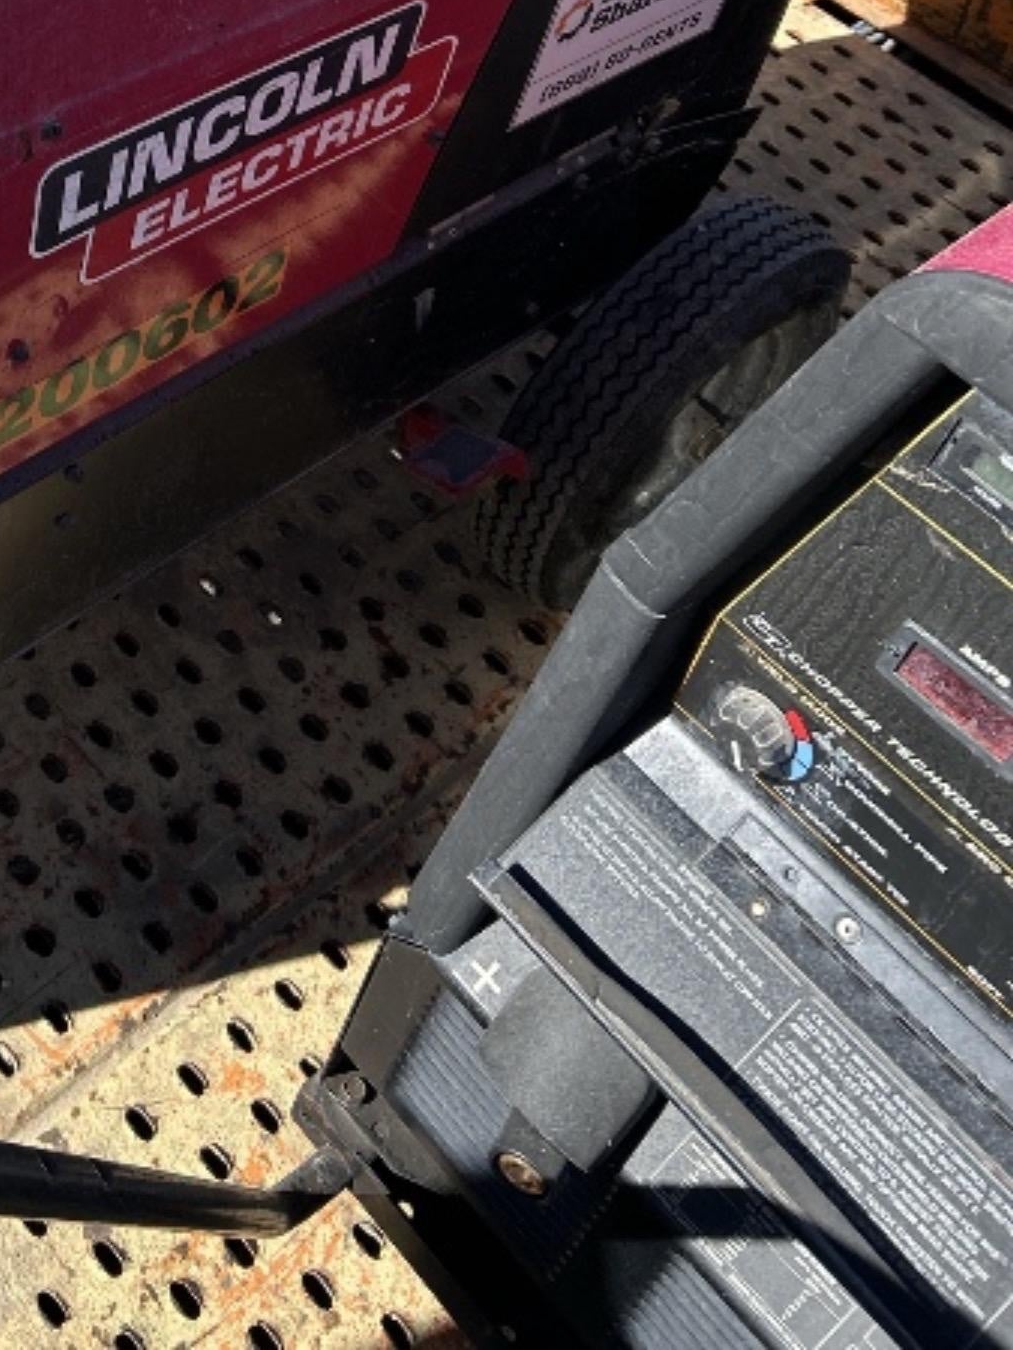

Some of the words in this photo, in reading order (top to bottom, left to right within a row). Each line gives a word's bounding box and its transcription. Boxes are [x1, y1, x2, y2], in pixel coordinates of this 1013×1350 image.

[57, 22, 400, 235] LINCOLN
[130, 82, 412, 251] ELECTRIC
[788, 651, 883, 733] CHOPPER
[958, 643, 1011, 689] AMPS
